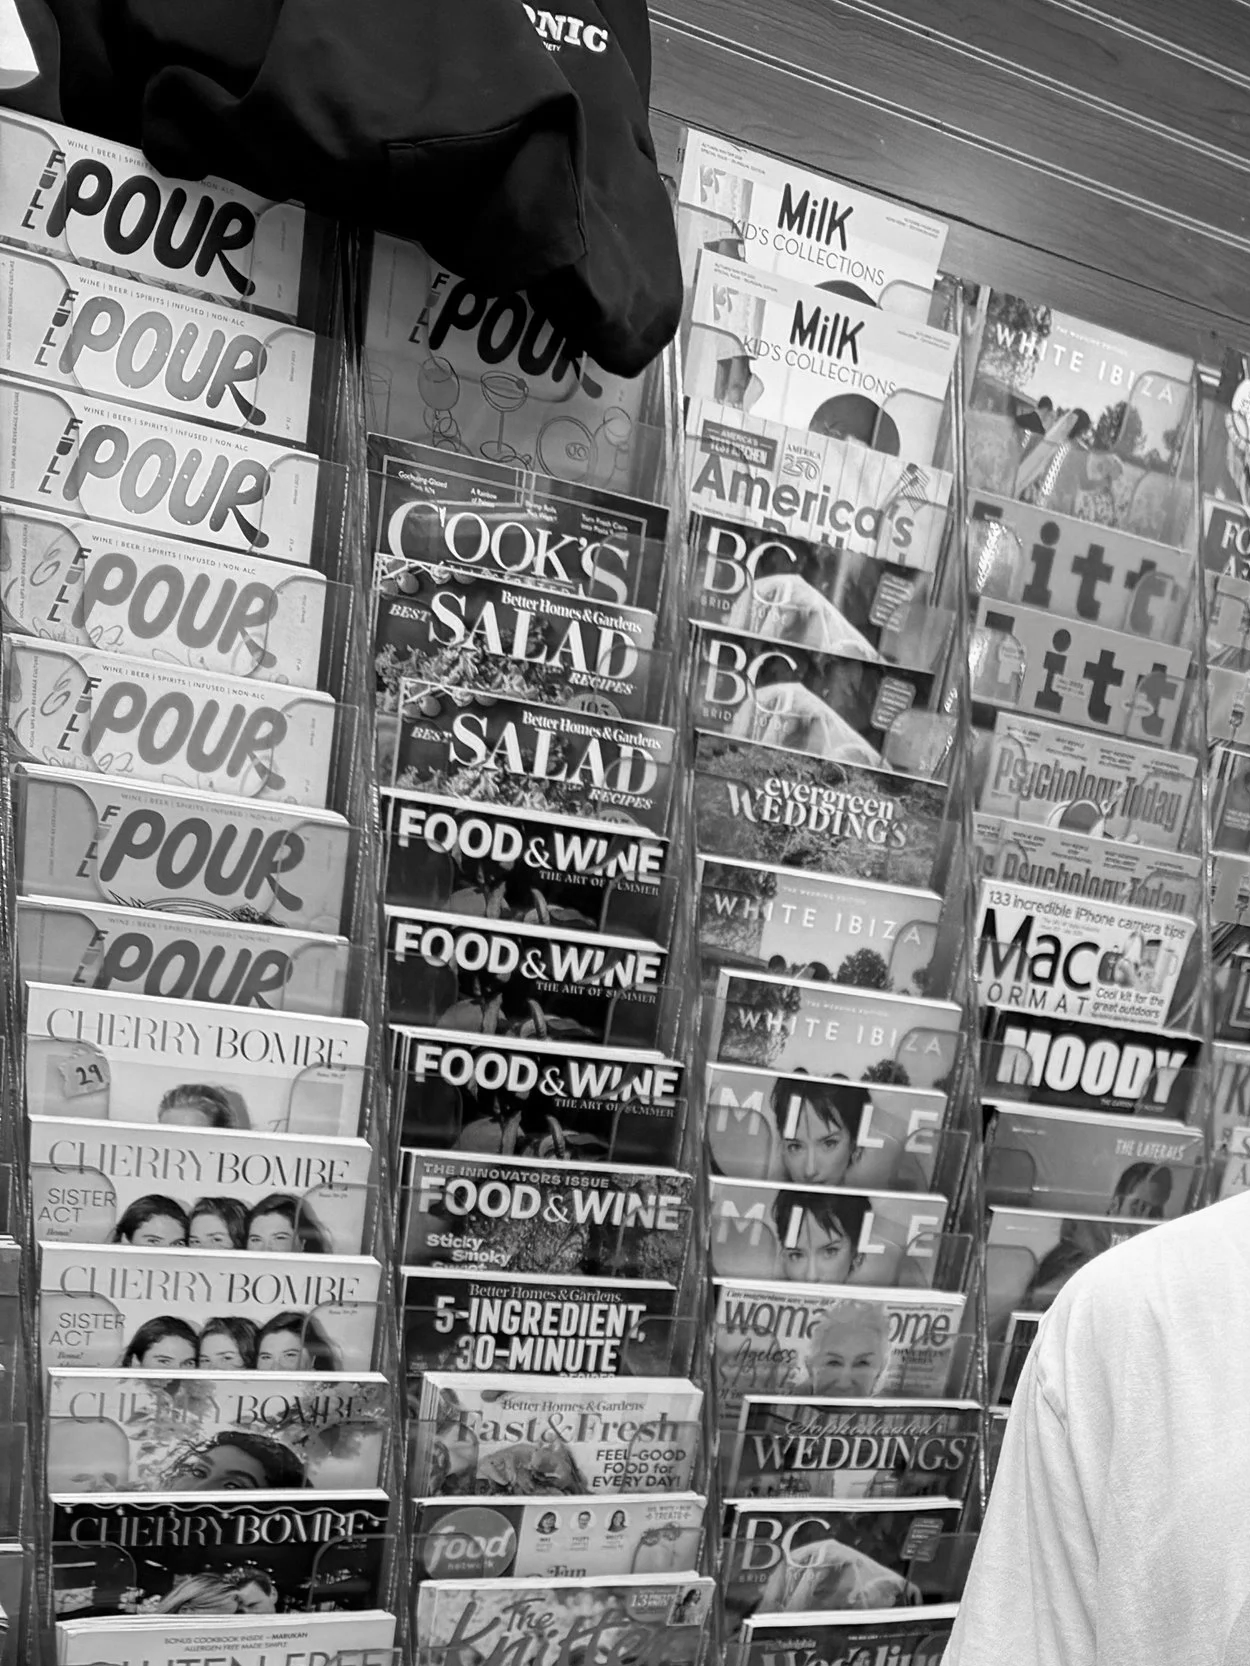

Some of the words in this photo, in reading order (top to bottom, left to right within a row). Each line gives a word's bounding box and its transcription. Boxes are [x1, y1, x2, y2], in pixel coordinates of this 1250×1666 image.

[46, 158, 256, 297] POUR
[731, 218, 770, 246] KID'S
[773, 233, 885, 287] COLLECTIONS
[79, 276, 100, 289] WINE
[108, 283, 128, 297] BEER
[136, 291, 165, 305] SPIRITS
[171, 301, 204, 316] INFUSED
[58, 296, 268, 426] POUR
[743, 335, 782, 362] KID'S
[785, 349, 898, 399] COLLECTIONS
[995, 324, 1084, 375] WHITE
[1098, 359, 1175, 406] IBIZA
[62, 424, 271, 549] POUR
[692, 453, 915, 548] America's
[387, 500, 631, 604] COOK'S
[71, 552, 279, 669] POUR
[389, 604, 431, 623] BEST
[428, 591, 638, 680] SALAD
[568, 670, 636, 696] RECIPES
[81, 681, 288, 790] POUR
[449, 713, 657, 796] SALAD
[588, 788, 653, 810] RECIPES
[727, 781, 907, 849] WEDDINGS
[764, 777, 894, 820] evergreen
[994, 748, 1123, 819] Psychology
[1123, 776, 1183, 834] Today
[398, 807, 523, 861] FOOD
[553, 832, 663, 885] WINE
[714, 893, 817, 928] WHITE
[835, 912, 922, 945] IBIZA
[988, 890, 1011, 906] 133
[1013, 895, 1072, 918] incredible
[1076, 906, 1116, 927] iPhone
[1118, 916, 1161, 936] camera
[1164, 923, 1187, 940] tips
[94, 932, 294, 1009] POUR
[977, 908, 1101, 992] Mac
[47, 1008, 201, 1056] CHERRY
[738, 1007, 841, 1041] WHITE
[857, 1024, 942, 1055] IBIZA
[415, 1044, 538, 1094] FOOD
[569, 1062, 678, 1108] WINE
[996, 1027, 1188, 1104] MOODY
[716, 1087, 939, 1154] MILE
[49, 1140, 201, 1182] CHERRY
[424, 1162, 456, 1176] THE
[460, 1166, 560, 1187] INNOVATORS
[565, 1175, 610, 1189] ISSUE
[38, 1206, 83, 1223] ACT
[48, 1188, 117, 1207] SISTER
[418, 1176, 541, 1220] FOOD
[572, 1189, 682, 1231] WINE
[426, 1233, 483, 1250] Sticky
[716, 1200, 939, 1258] MILE
[452, 1249, 512, 1266] Smoky
[59, 1265, 212, 1302] CHERRY
[49, 1331, 94, 1346] ACT
[58, 1313, 126, 1329] SISTER
[433, 1296, 646, 1341] 5-INGREDIENT,
[455, 1334, 621, 1373] 30-MINUTE
[596, 1449, 687, 1462] FEEL-GOOD
[604, 1463, 649, 1475] FOOD
[653, 1462, 674, 1475] for
[753, 1435, 968, 1472] WEDDINGS
[592, 1476, 643, 1488] EVERY
[646, 1475, 681, 1488] DAY!
[70, 1517, 223, 1548] CHERRY
[430, 1526, 513, 1569] food
